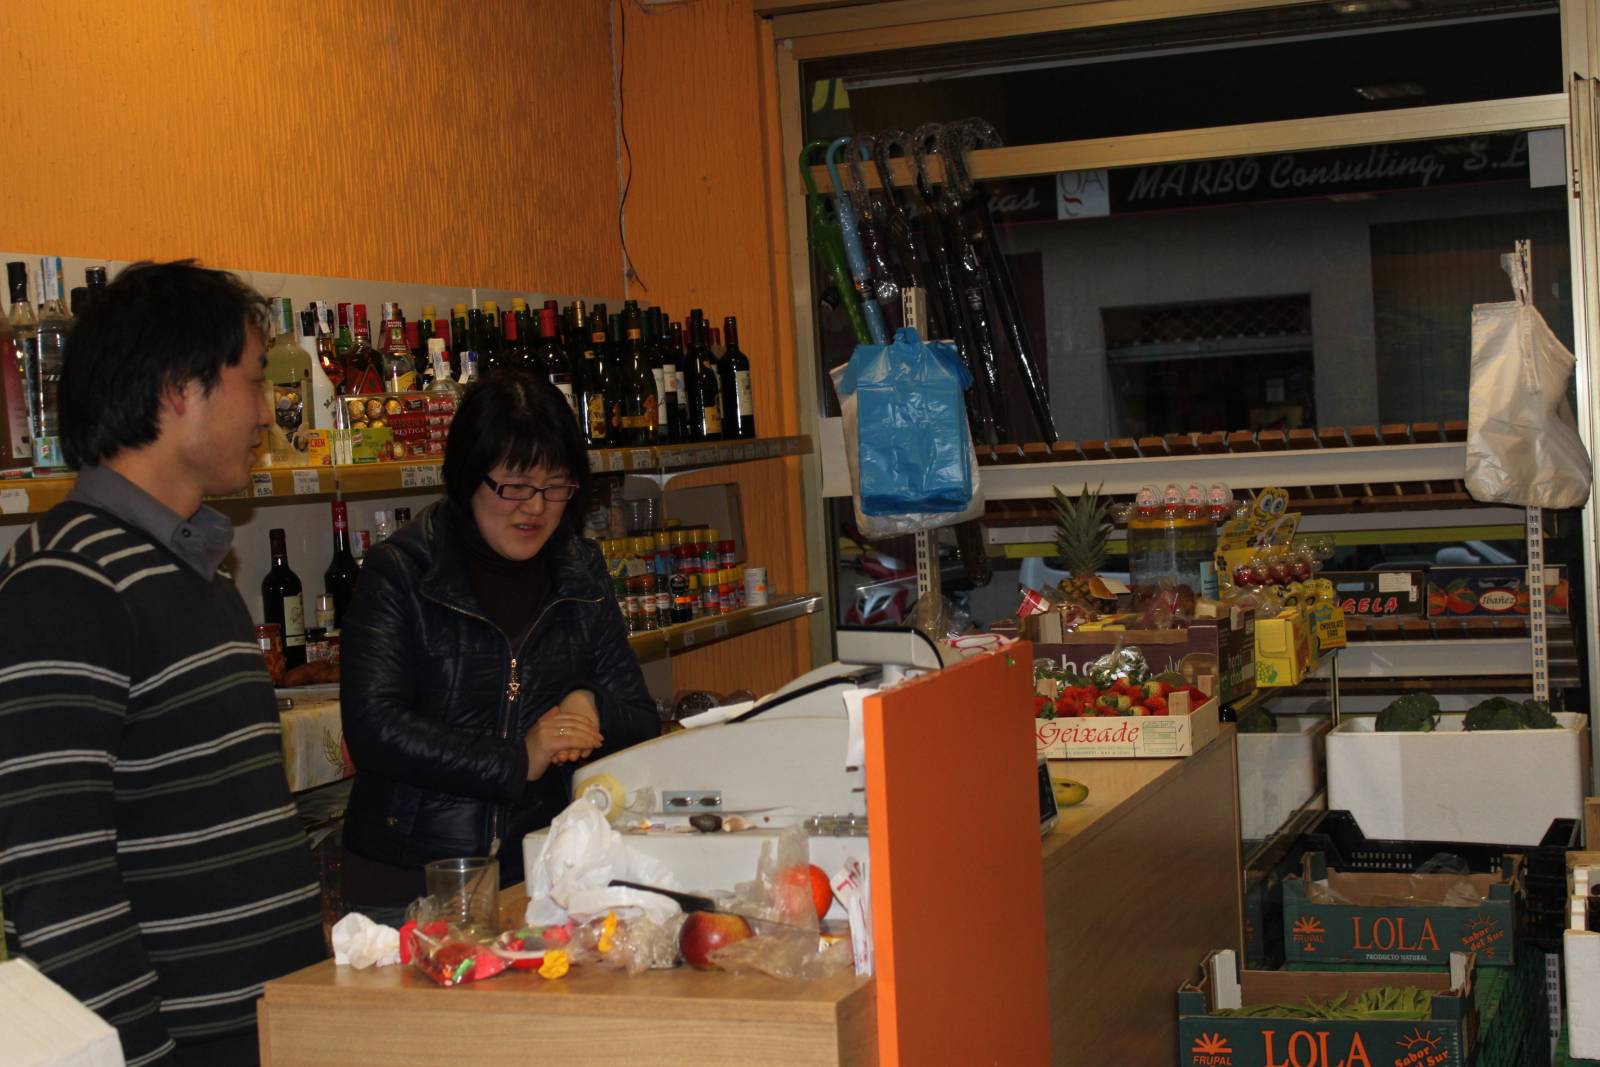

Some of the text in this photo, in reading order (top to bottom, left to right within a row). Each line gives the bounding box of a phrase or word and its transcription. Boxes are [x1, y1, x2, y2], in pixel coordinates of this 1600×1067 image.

[1127, 158, 1261, 202] MARBO
[1292, 934, 1327, 944] FRUPAL
[1352, 916, 1440, 952] LOLA
[1461, 927, 1490, 945] Sabor
[1487, 929, 1506, 945] Sur
[1365, 952, 1428, 962] PRODUCTO NATURAL
[1261, 1029, 1373, 1067] LOLA
[1393, 1045, 1431, 1067] Sabor
[1192, 1055, 1233, 1066] FRUPAL
